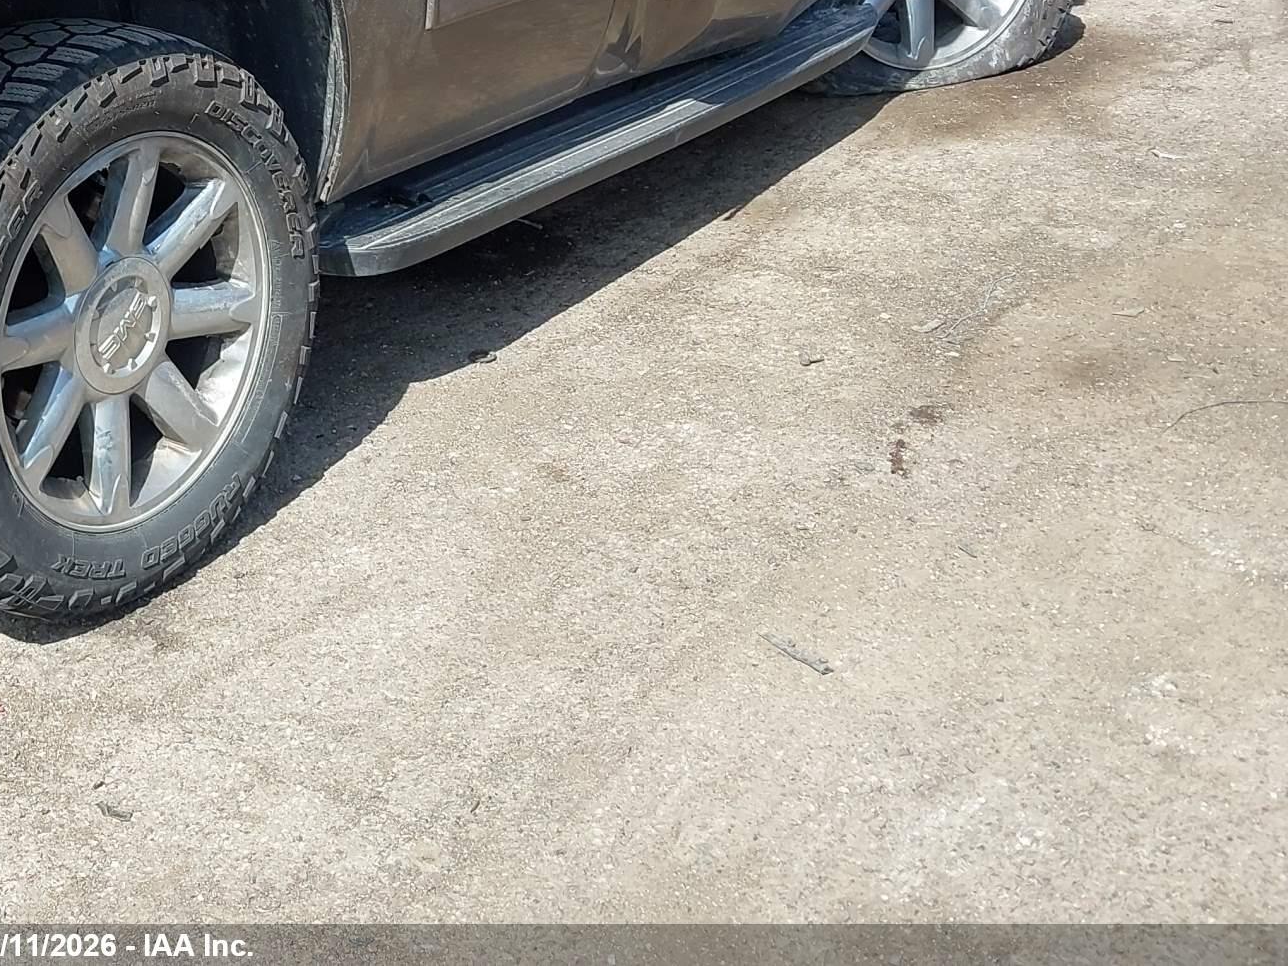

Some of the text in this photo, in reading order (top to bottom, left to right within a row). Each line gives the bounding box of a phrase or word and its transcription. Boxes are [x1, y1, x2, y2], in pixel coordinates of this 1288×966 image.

[204, 99, 305, 258] DISCOVERER
[98, 291, 148, 360] GMC
[51, 472, 241, 579] RUGGED TREK
